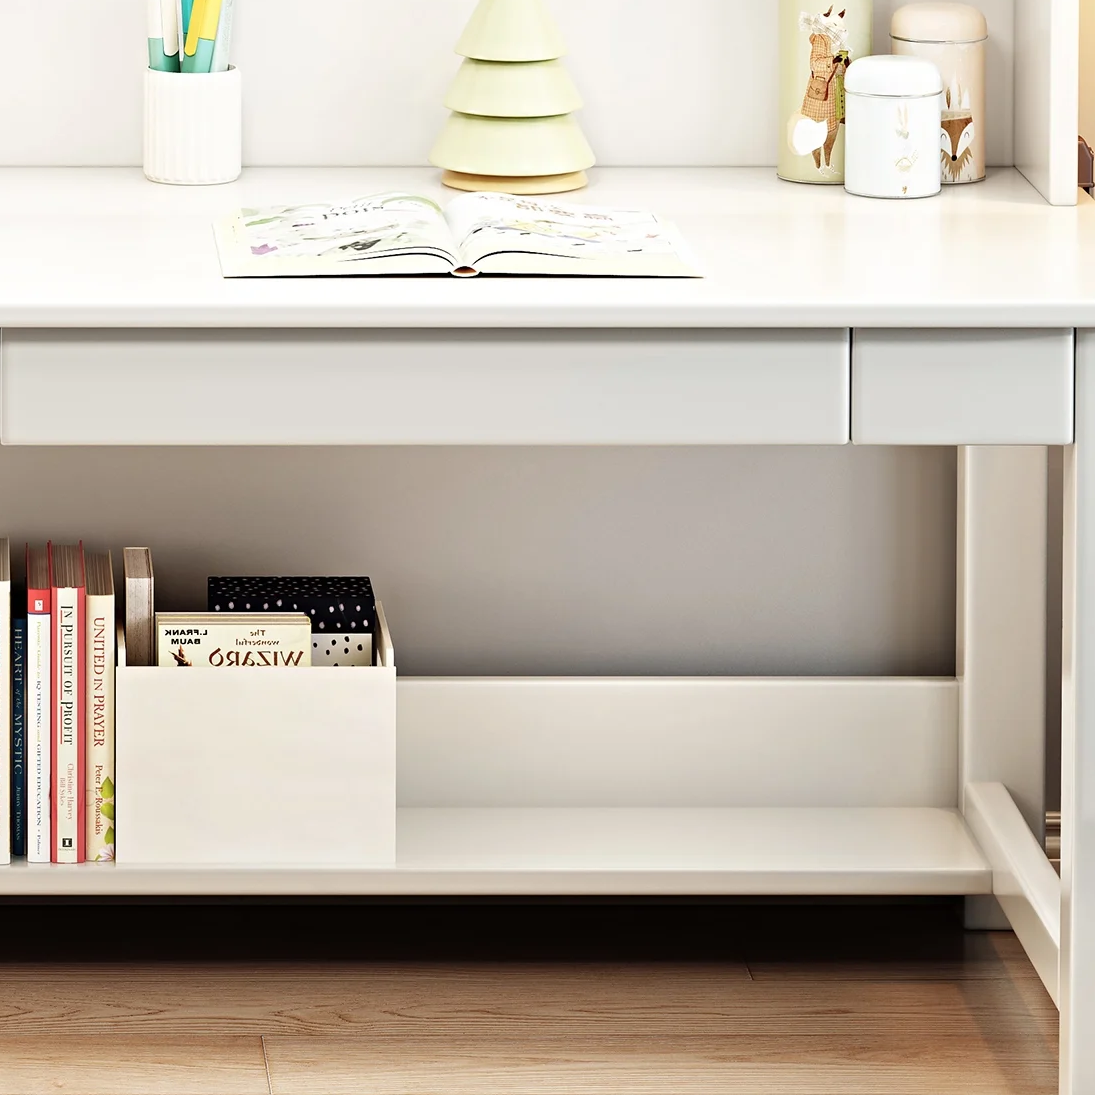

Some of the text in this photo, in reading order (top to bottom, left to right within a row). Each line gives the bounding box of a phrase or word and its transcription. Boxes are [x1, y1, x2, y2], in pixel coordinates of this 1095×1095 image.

[62, 606, 73, 745] IN PURSUIT OF PROFIT
[94, 618, 104, 746] UNITED IN PRAYER
